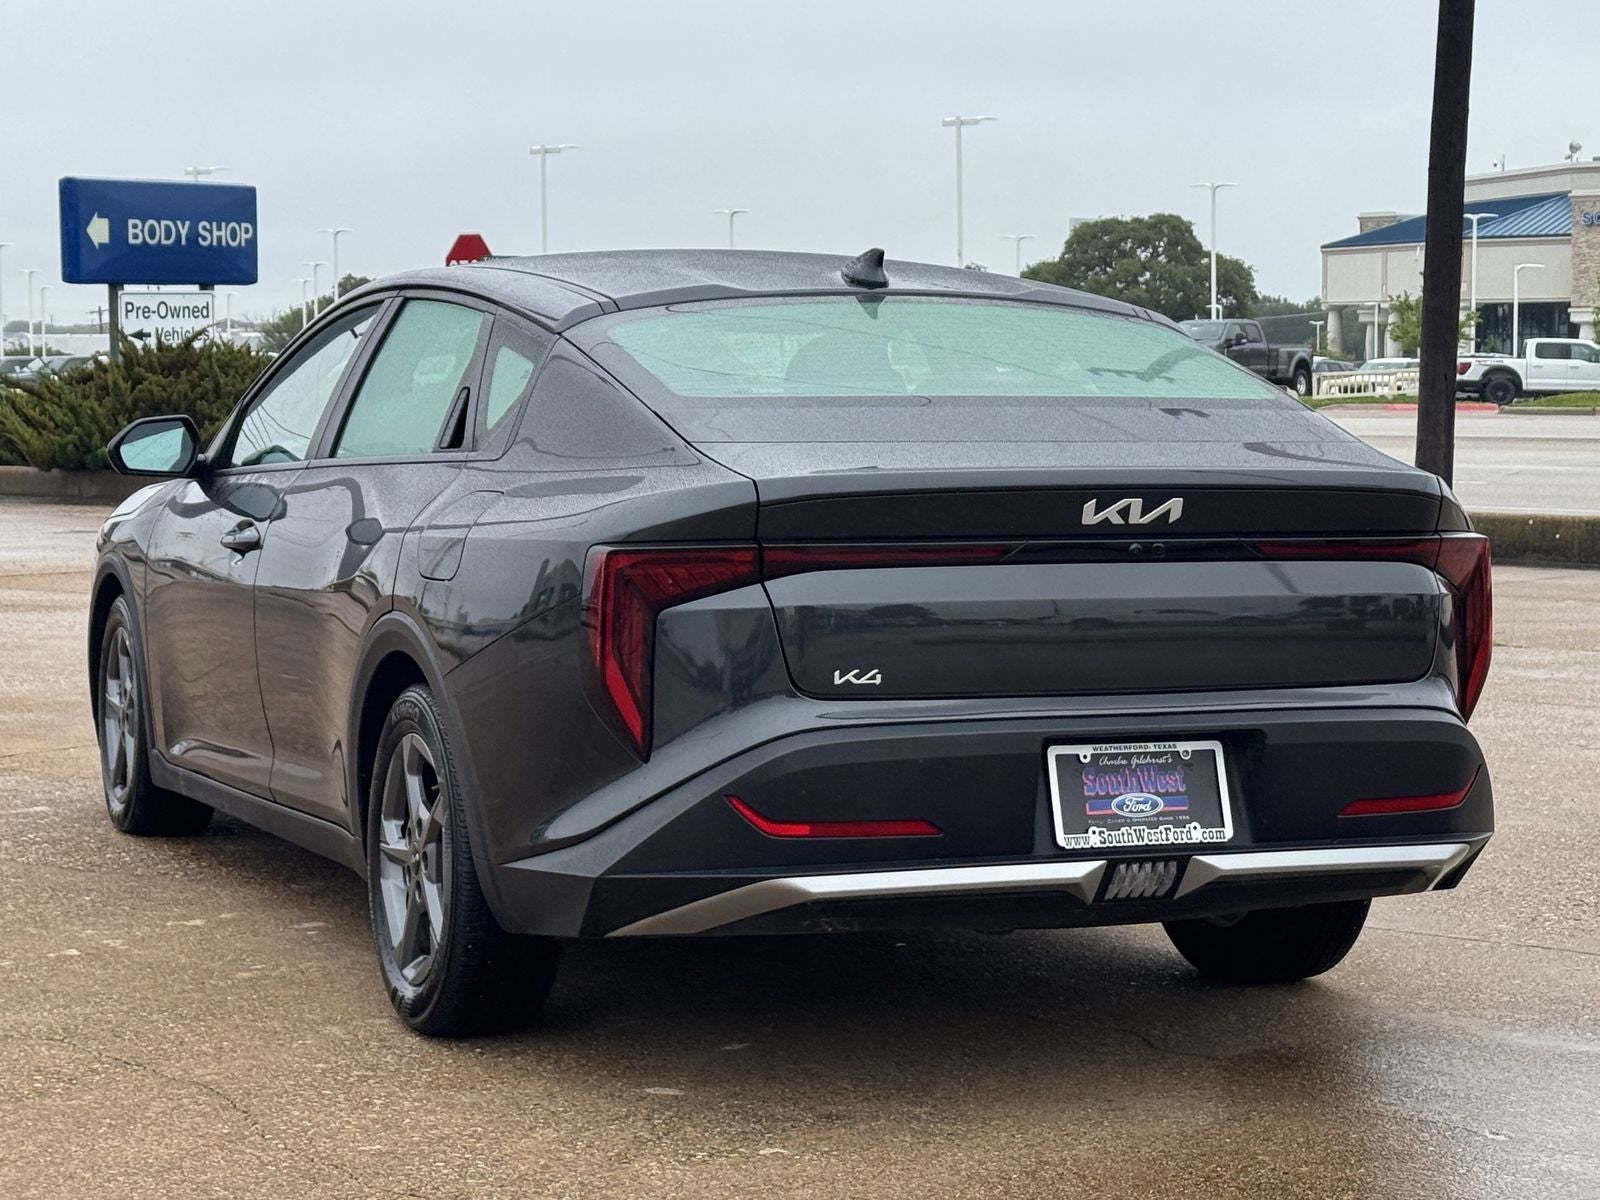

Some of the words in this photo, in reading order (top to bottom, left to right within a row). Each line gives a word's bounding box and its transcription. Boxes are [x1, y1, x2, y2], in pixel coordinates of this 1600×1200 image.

[127, 218, 190, 246] BODY
[198, 220, 253, 248] SHOP
[125, 301, 210, 320] Pre-Owned
[1081, 497, 1184, 525] KIA
[833, 668, 882, 685] K4
[1123, 796, 1152, 811] Ford
